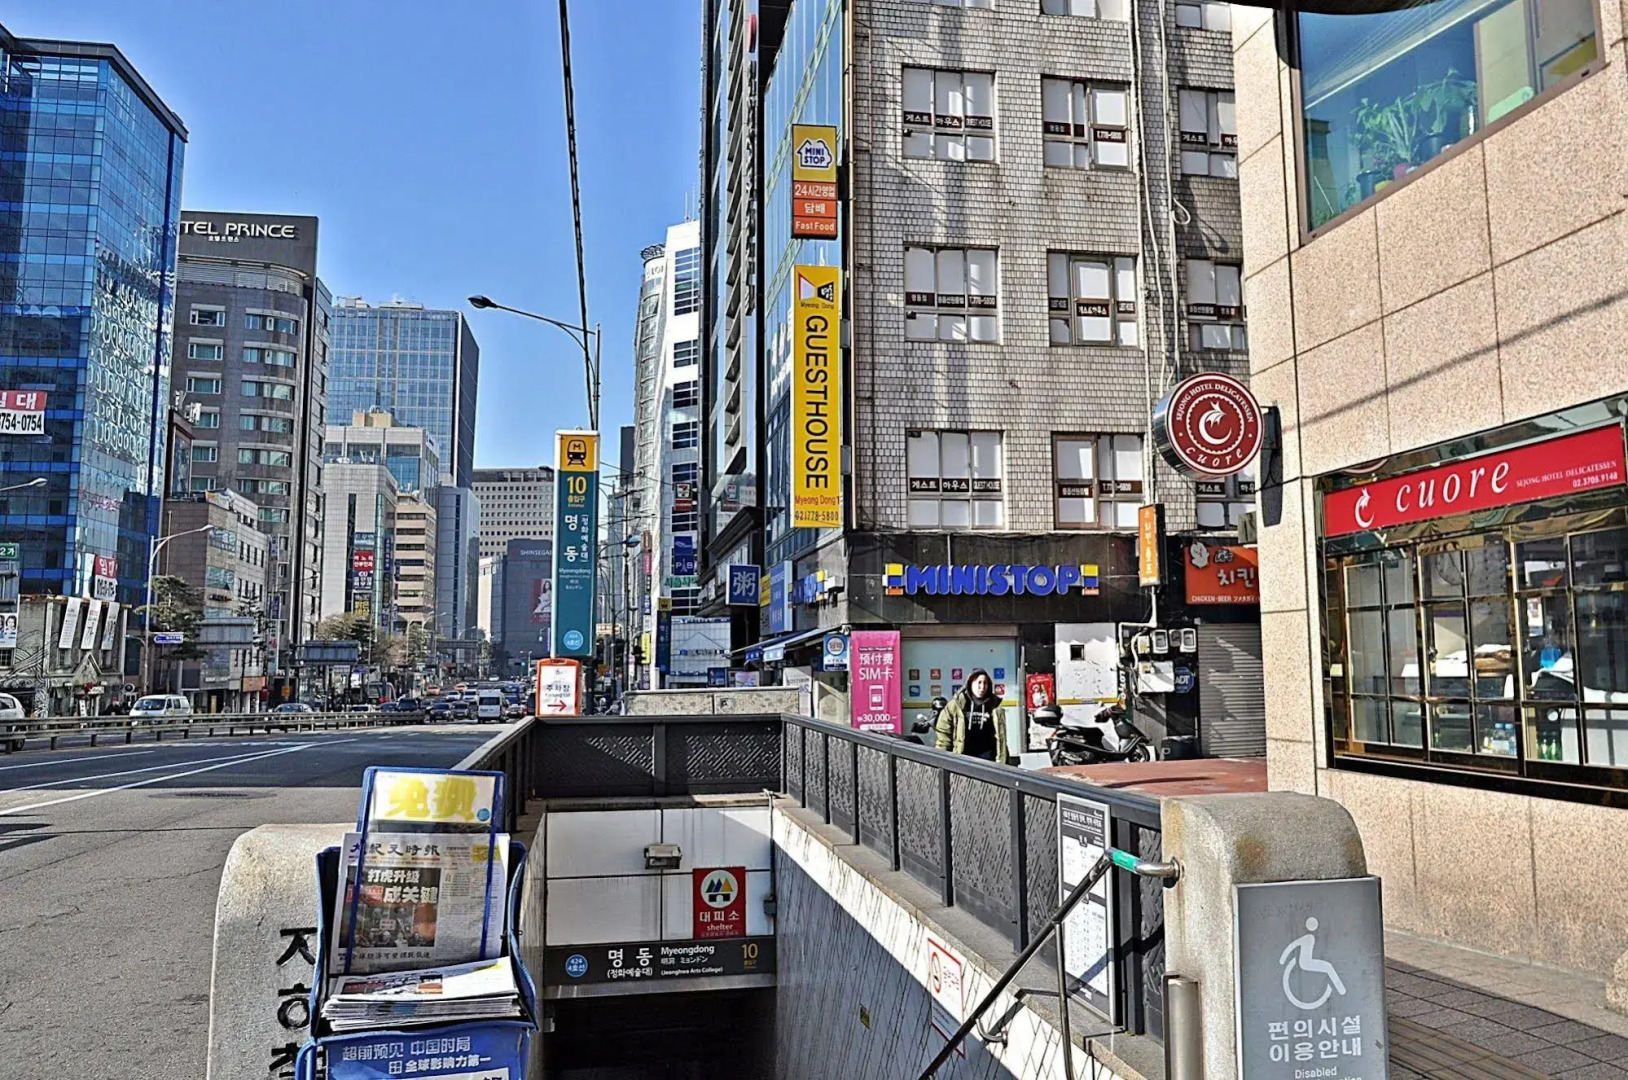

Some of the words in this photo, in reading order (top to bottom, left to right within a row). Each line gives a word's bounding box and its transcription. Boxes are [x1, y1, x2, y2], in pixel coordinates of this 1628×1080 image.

[804, 155, 826, 165] STOP
[805, 146, 825, 157] MINI
[795, 184, 835, 198] 24시간영업
[804, 202, 826, 214] 담배
[225, 222, 295, 238] PRINCE
[796, 221, 813, 230] Fast
[815, 222, 834, 231] Food
[805, 315, 828, 489] GUESTHOUSE
[1176, 393, 1191, 421] SEJONG
[1190, 383, 1213, 396] HOTEL
[1214, 383, 1254, 423] DELICATESSEN
[1185, 446, 1243, 467] cuore
[1516, 476, 1540, 488] SEJONG
[1541, 471, 1564, 482] HOTEL
[1565, 460, 1617, 478] DELICATESSEN
[567, 476, 587, 494] 10
[911, 481, 937, 489] 게스트
[1396, 461, 1510, 513] cuore
[564, 515, 579, 562] 명동
[733, 571, 756, 597] 粥
[905, 564, 1080, 596] MINISTOP
[1218, 568, 1255, 587] 치킨
[859, 667, 894, 680] SIM卡
[700, 910, 740, 923] 대피소
[706, 923, 733, 931] shelter
[608, 948, 654, 968] 명동
[661, 944, 715, 957] Myeongdong
[741, 943, 758, 959] 10
[1268, 1014, 1361, 1041] 편의시설
[410, 1036, 471, 1055] 中国时局
[1269, 1037, 1362, 1063] 이용안내
[1295, 1066, 1338, 1080] Disabled
